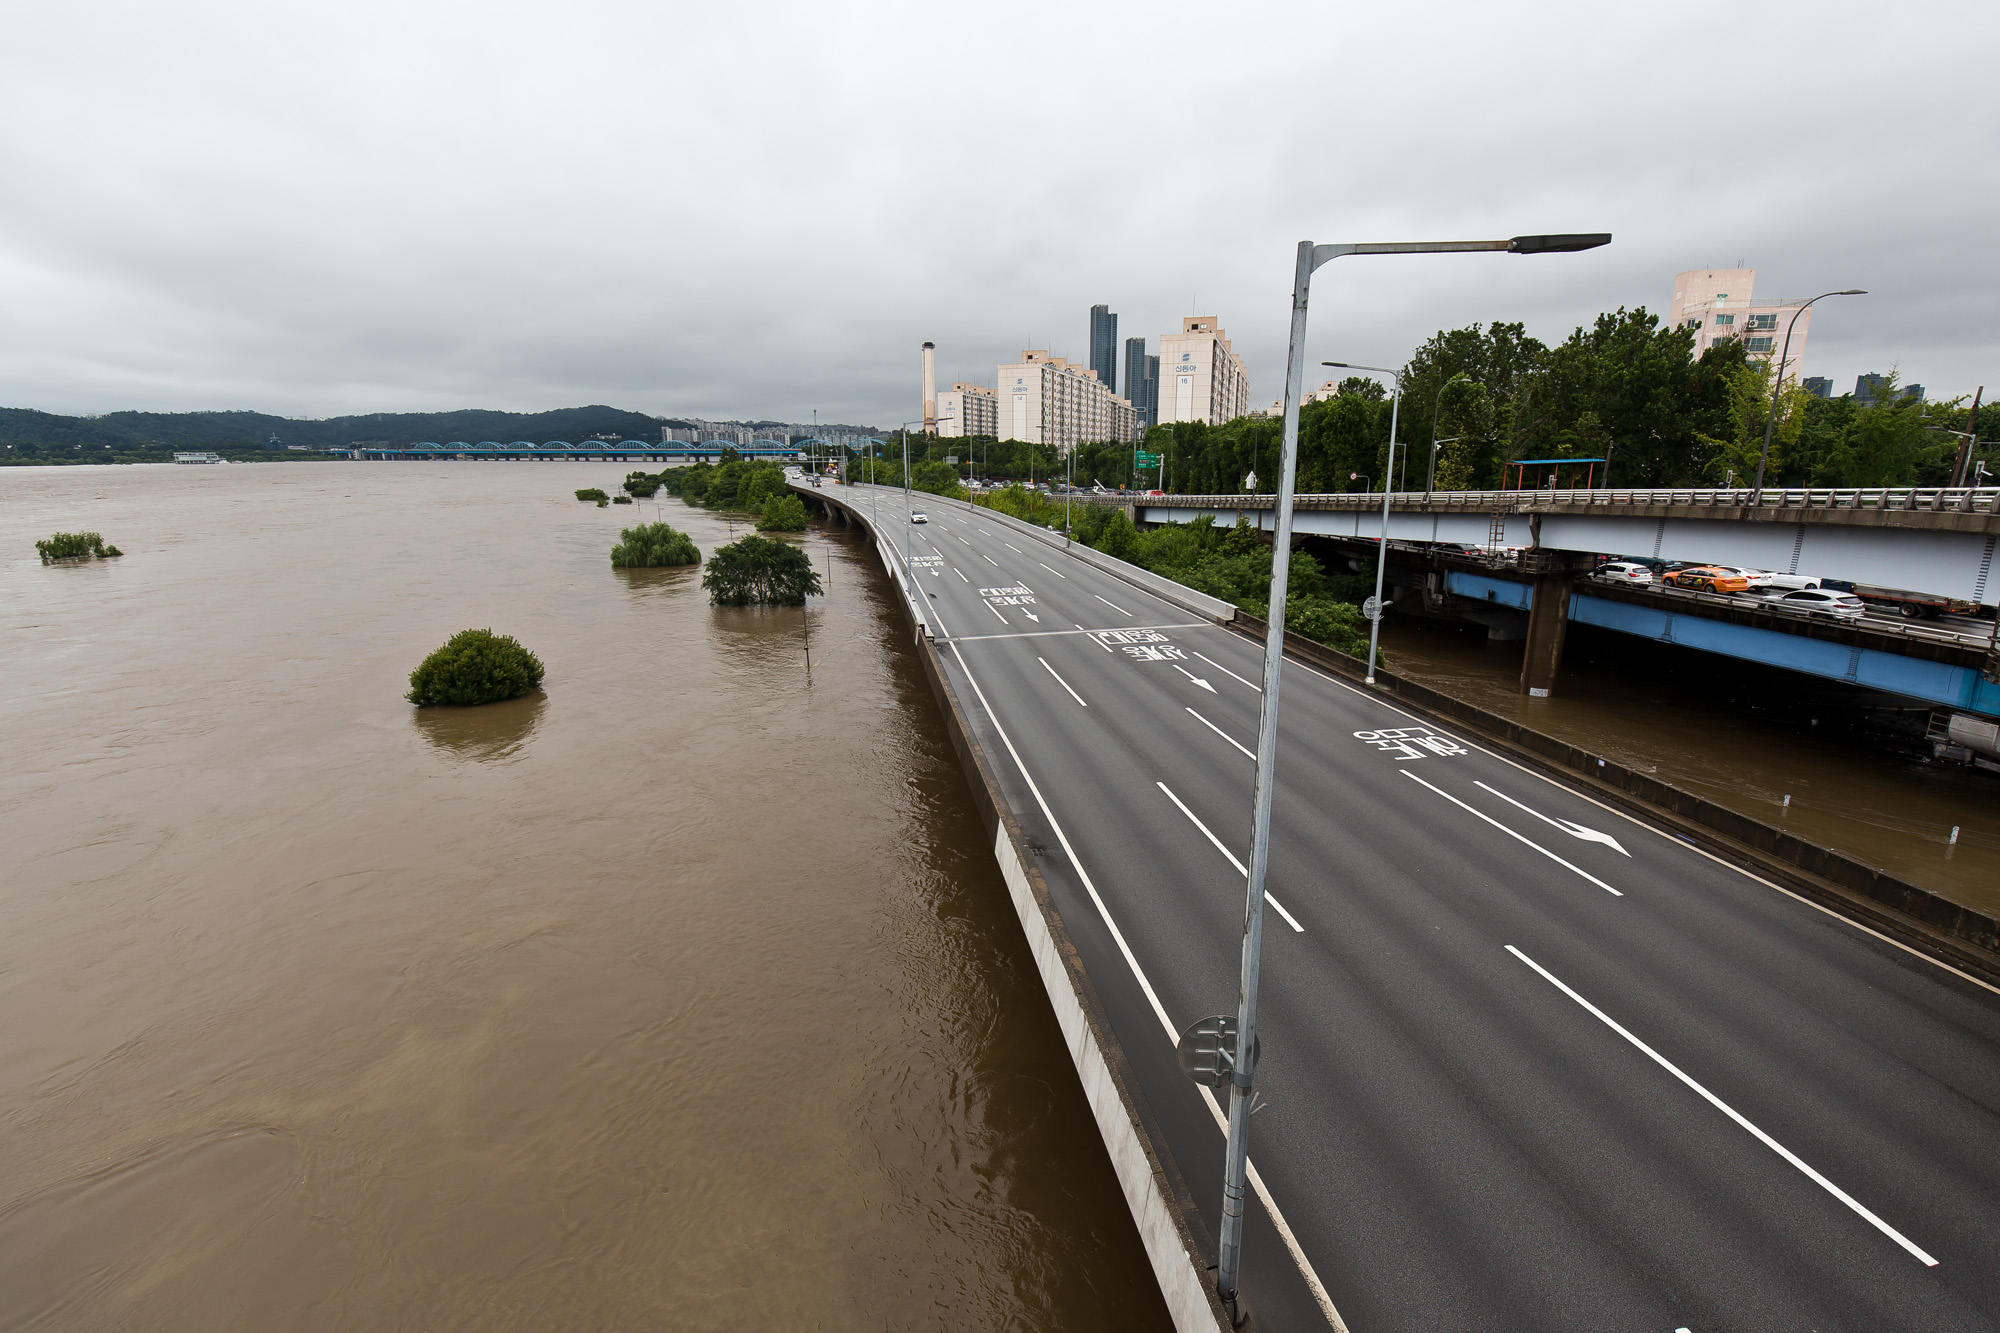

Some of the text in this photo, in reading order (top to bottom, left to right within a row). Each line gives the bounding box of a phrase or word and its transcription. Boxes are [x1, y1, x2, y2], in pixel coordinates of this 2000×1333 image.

[1175, 364, 1197, 373] 신동아
[1095, 630, 1169, 644] 영동대교
[1121, 645, 1188, 661] 상계동
[1353, 727, 1468, 760] 한남동
